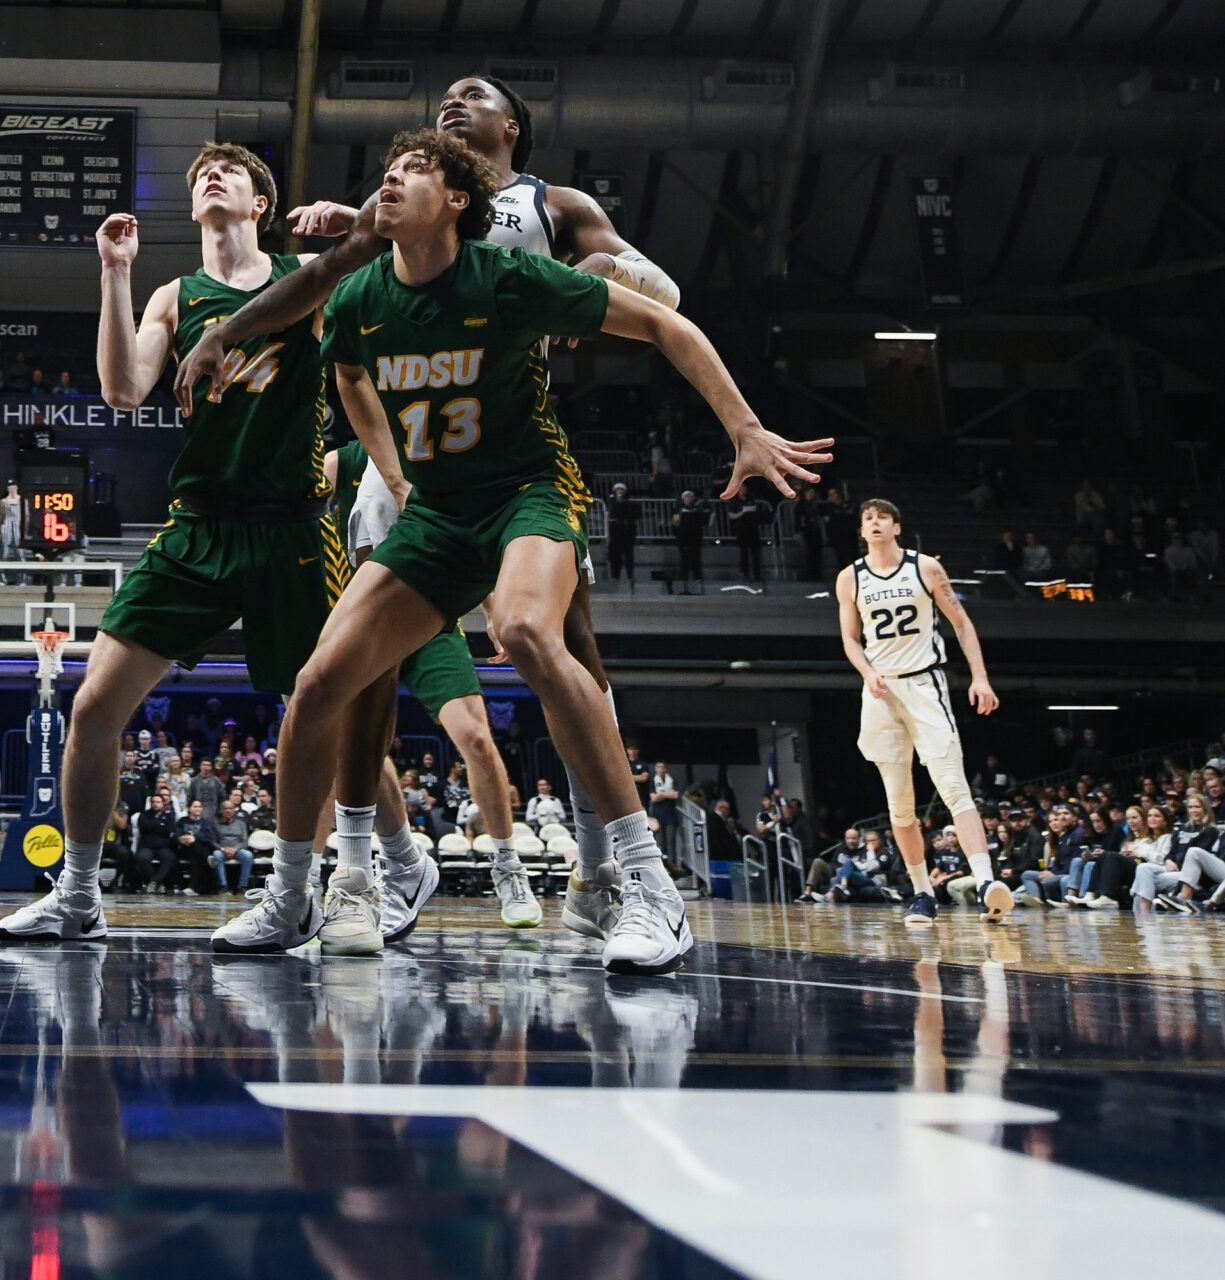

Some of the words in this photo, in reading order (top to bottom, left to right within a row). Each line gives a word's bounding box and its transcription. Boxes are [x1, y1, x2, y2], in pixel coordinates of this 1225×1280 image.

[83, 157, 119, 167] CREIGHTON
[30, 171, 75, 182] GEORGETOWN
[83, 173, 121, 184] MARQUETTE
[34, 187, 54, 198] SETON
[55, 188, 71, 198] HALL
[83, 205, 107, 215] XAVIER
[494, 211, 523, 233] ER
[377, 348, 485, 391] NDSU
[4, 403, 105, 426] HINKLE
[398, 397, 482, 461] 13
[864, 588, 915, 605] BUTLER
[871, 605, 920, 640] 22
[40, 713, 51, 773] BUTLER
